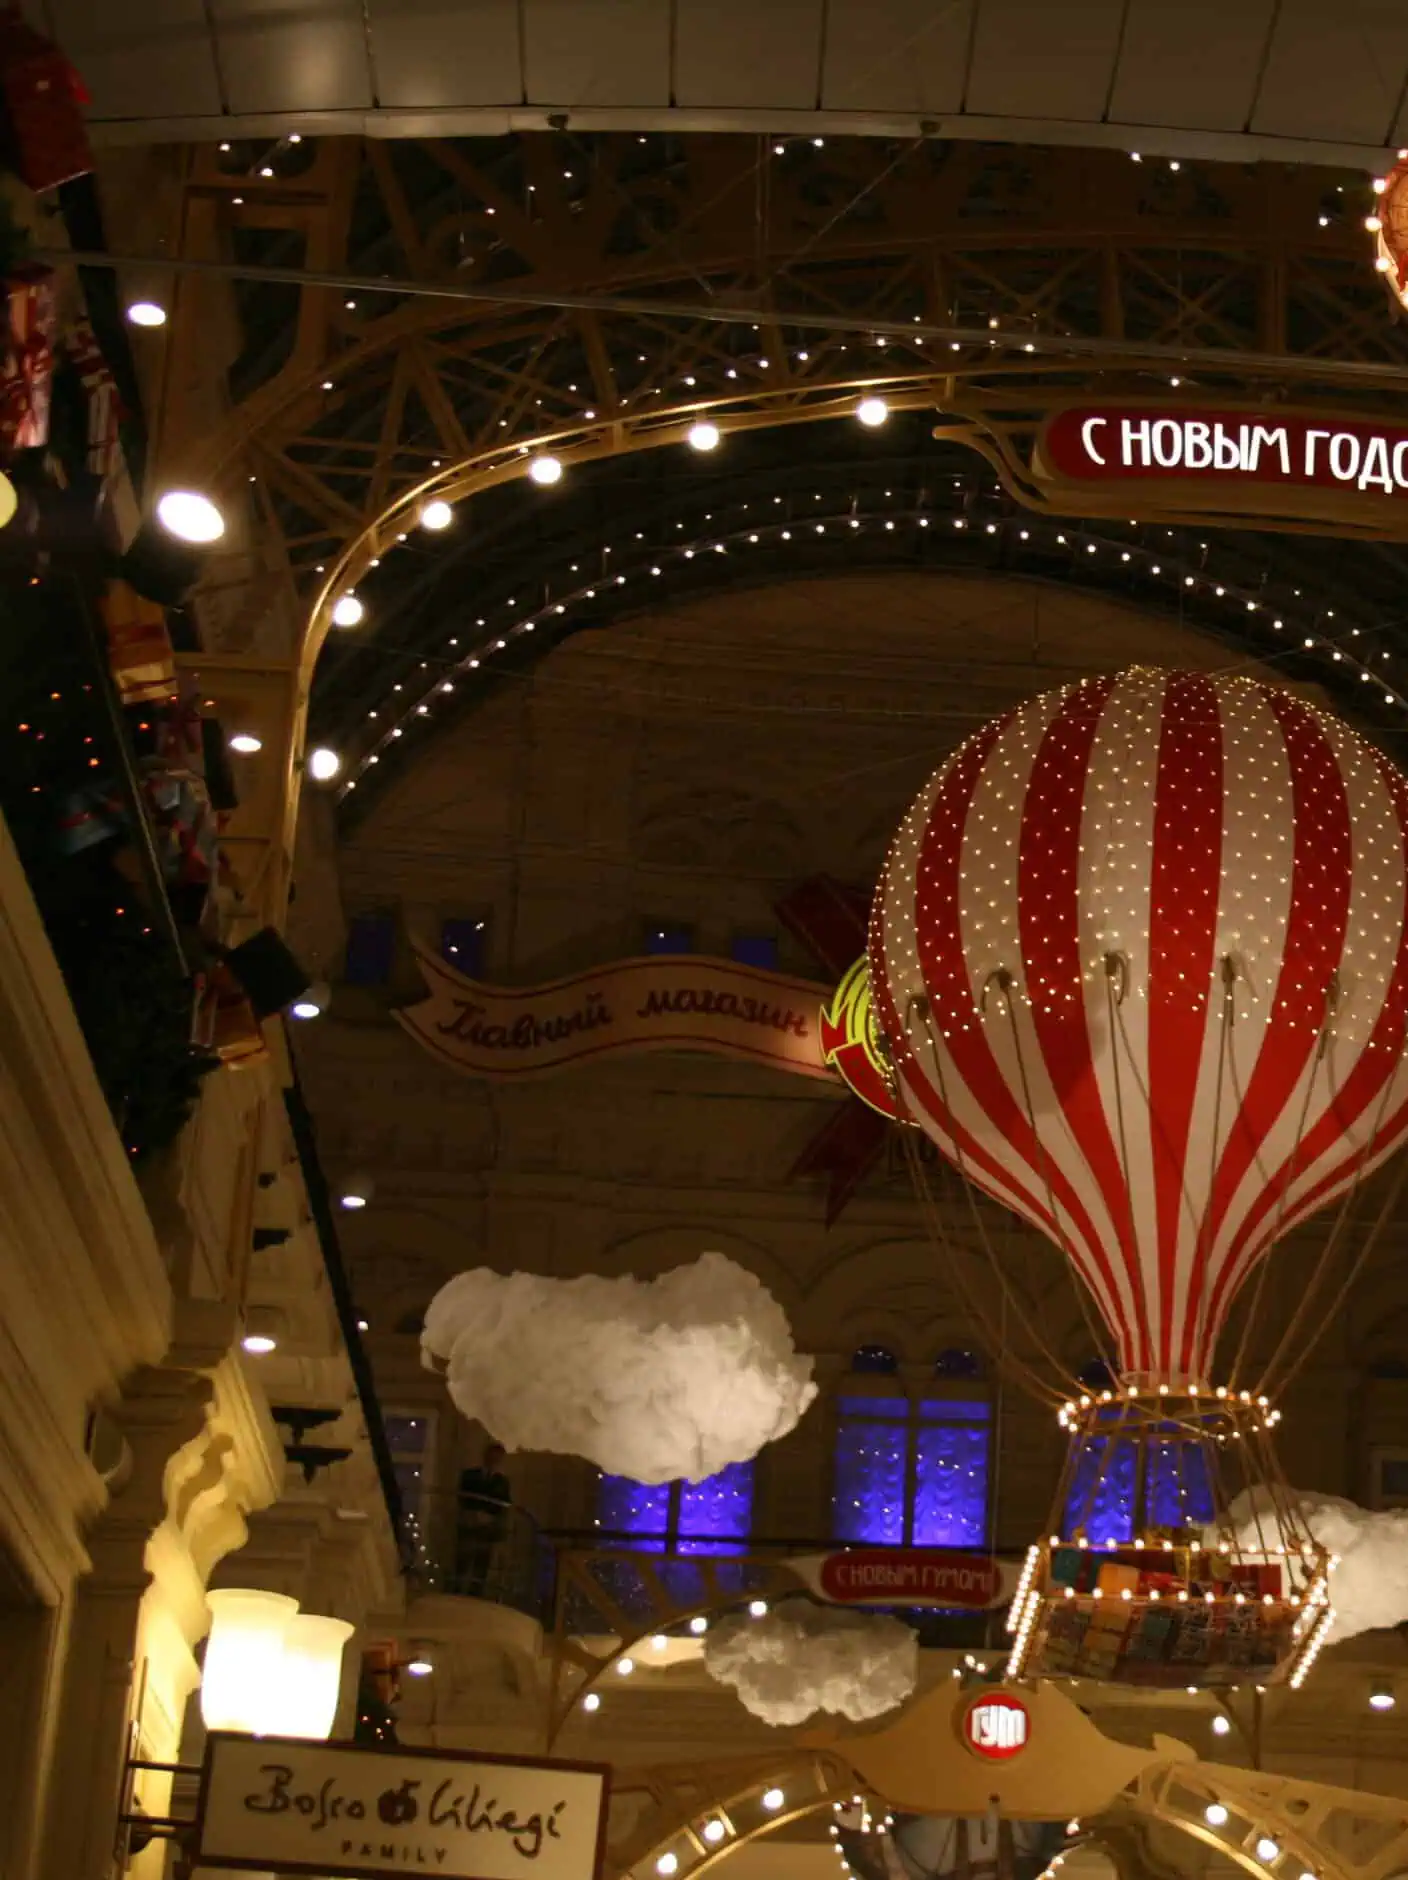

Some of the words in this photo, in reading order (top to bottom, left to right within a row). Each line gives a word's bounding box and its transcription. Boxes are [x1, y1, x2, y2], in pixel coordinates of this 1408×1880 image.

[1081, 417, 1107, 466] С
[1120, 418, 1291, 475] НОВЫМ
[436, 992, 613, 1050] Главный
[636, 988, 809, 1038] магазин
[835, 1565, 848, 1588] С
[850, 1564, 918, 1588] НОВЫМ
[243, 1763, 366, 1832] Bosco
[340, 1839, 448, 1865] FAMILY
